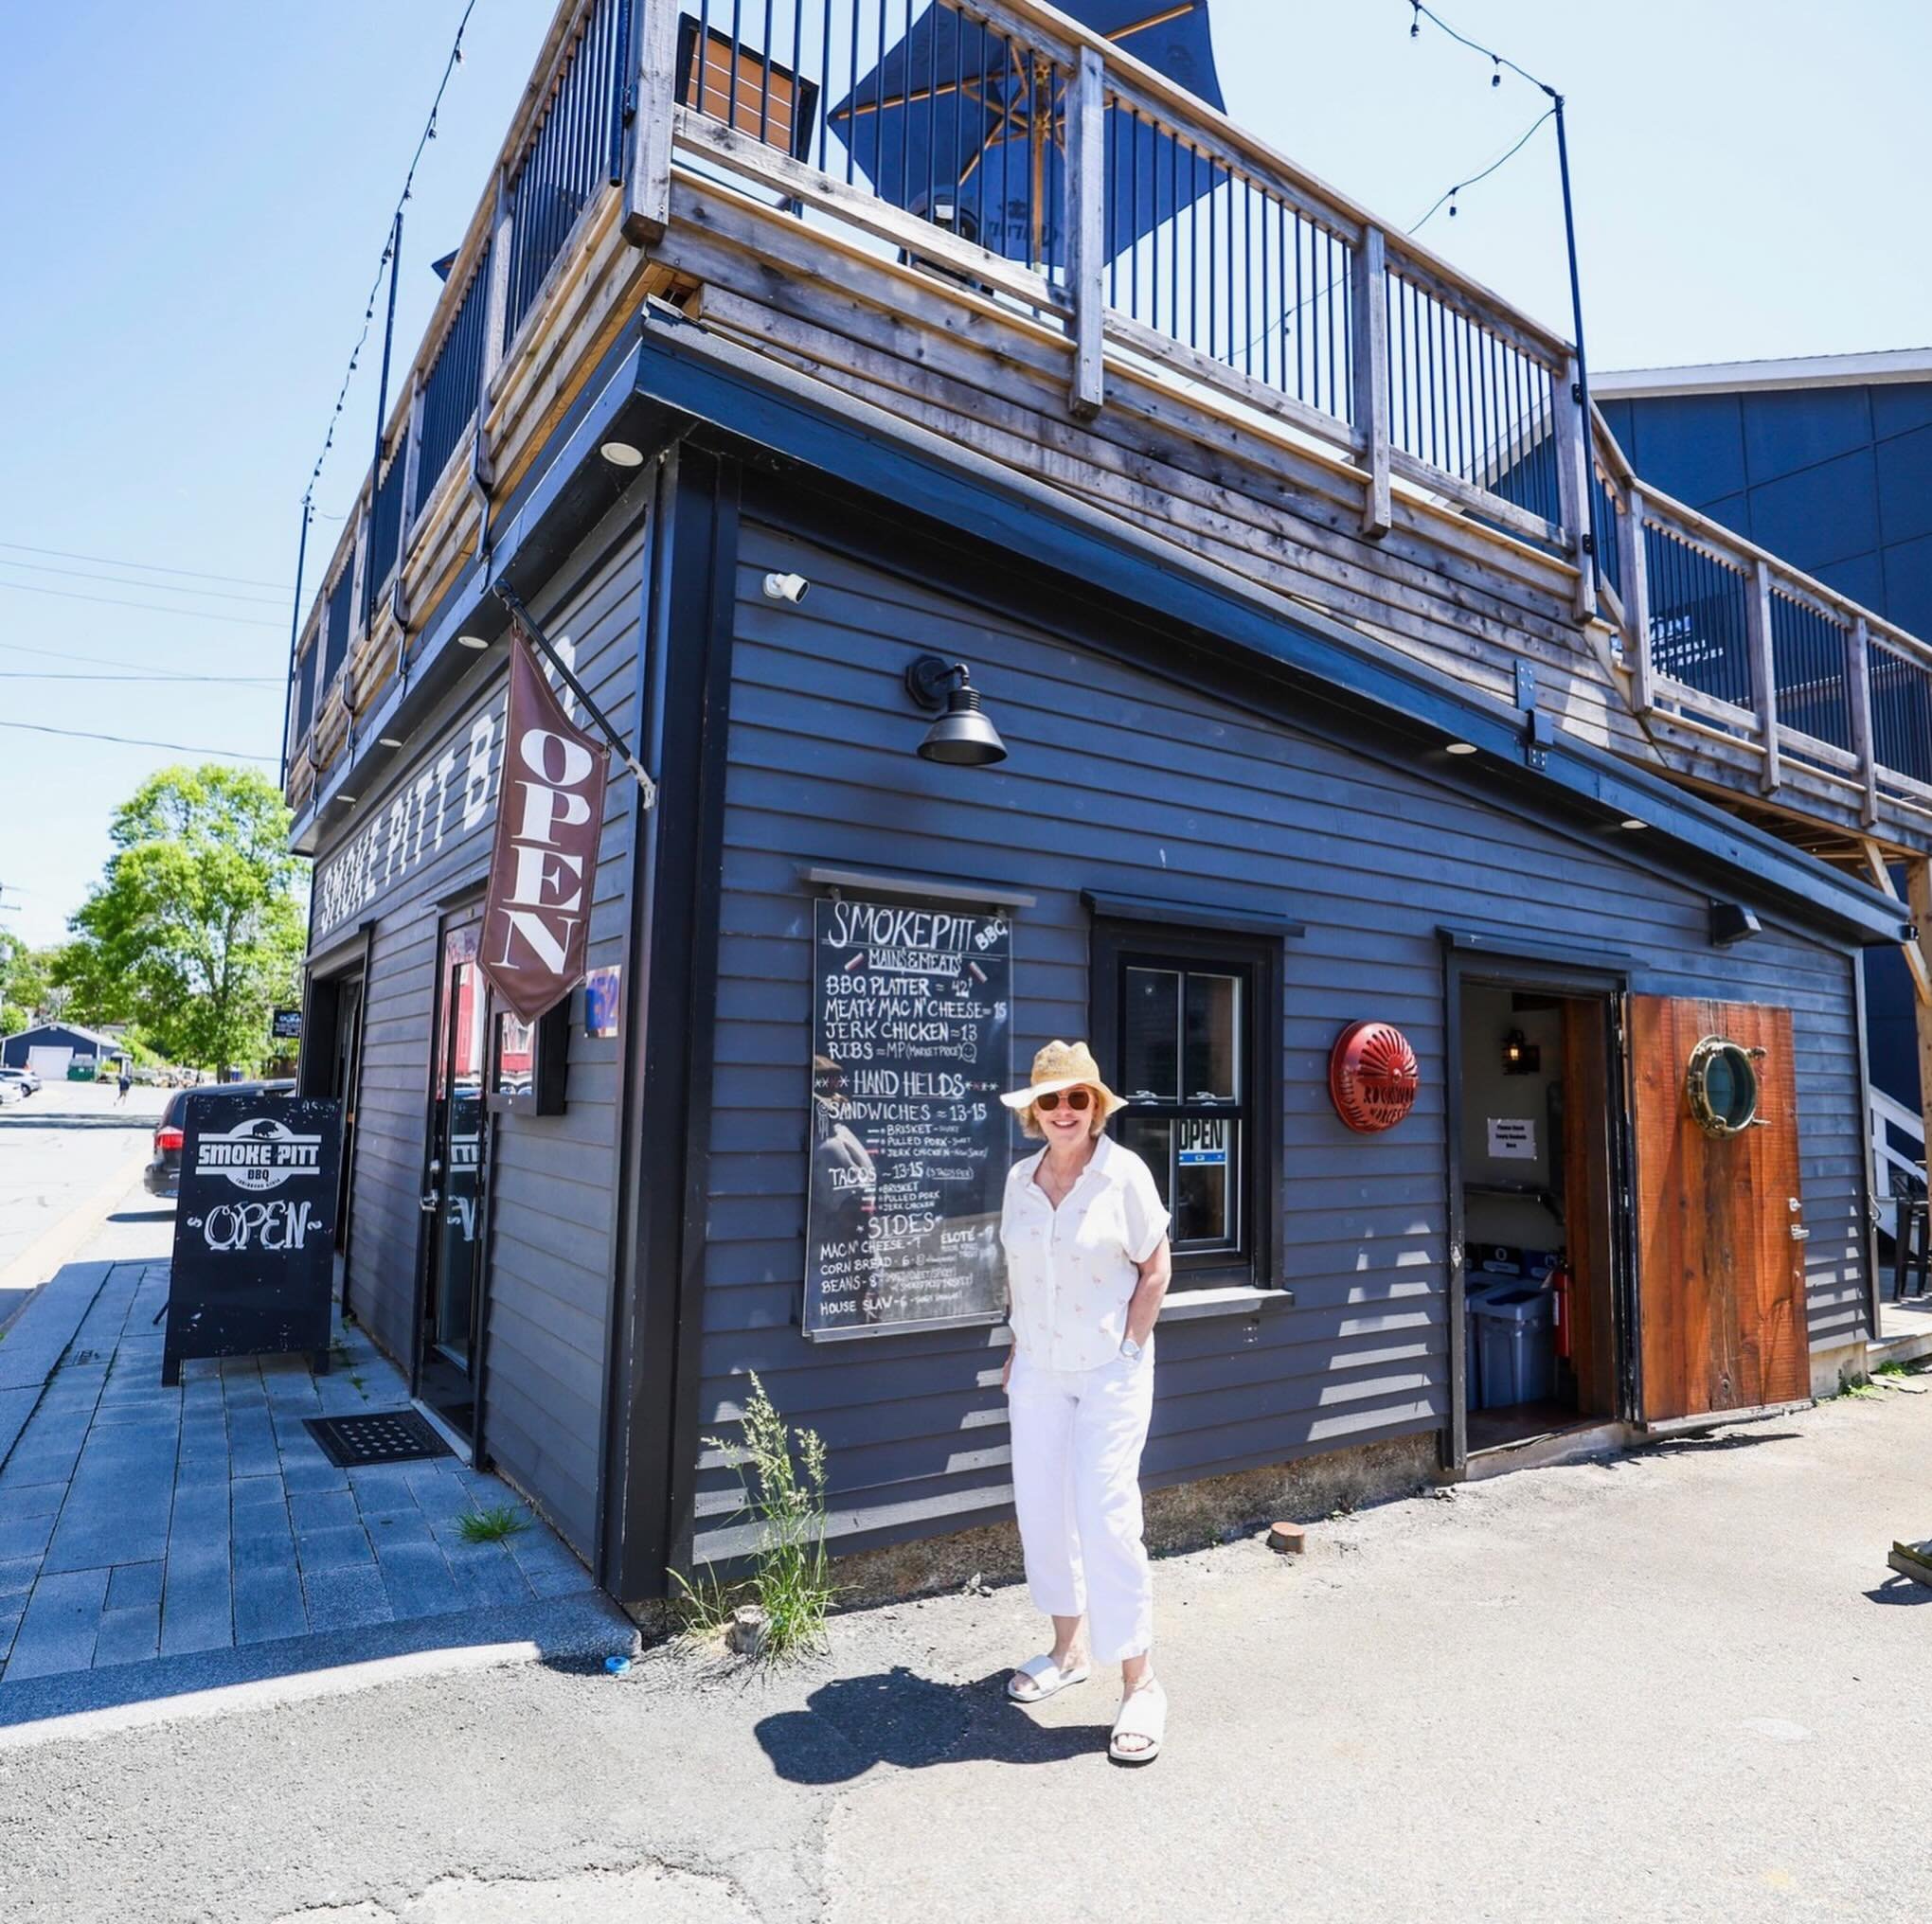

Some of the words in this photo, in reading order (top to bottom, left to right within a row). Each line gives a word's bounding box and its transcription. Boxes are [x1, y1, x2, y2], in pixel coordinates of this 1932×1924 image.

[321, 816, 382, 935] SMOKE
[385, 747, 456, 887] PITT
[490, 728, 593, 975] OPEN
[975, 919, 1009, 951] BBQ
[826, 975, 866, 996] BBQ
[870, 974, 931, 997] PLATTER
[824, 997, 875, 1022] MEATY
[877, 998, 910, 1022] MAC
[927, 999, 983, 1018] CHEESE
[826, 1021, 877, 1039] JERK
[881, 1022, 948, 1042] CHICKEN
[827, 1042, 873, 1060] RIBS
[853, 1069, 899, 1096] HAND
[903, 1071, 965, 1096] HELDS
[829, 1101, 930, 1121] SANDWICHES
[886, 1124, 932, 1136] BRISKET
[1178, 1118, 1224, 1149] OPEN
[886, 1136, 921, 1147] PULLED
[924, 1136, 947, 1147] PORK
[198, 1144, 271, 1166] SMOKE
[277, 1145, 319, 1166] PITT
[247, 1168, 269, 1182] BBQ
[829, 1166, 876, 1186] TACOS
[882, 1181, 920, 1193] BRISKET
[884, 1193, 917, 1203] PULLED
[919, 1190, 940, 1201] PORK
[204, 1199, 312, 1251] OPEN
[868, 1212, 935, 1239] SIDES
[820, 1241, 847, 1261] MAC
[861, 1239, 906, 1255] CHEESE
[820, 1261, 851, 1275] CORN
[853, 1256, 892, 1271] BREAD
[820, 1300, 857, 1316] HOUSE
[862, 1295, 893, 1311] SLAW
